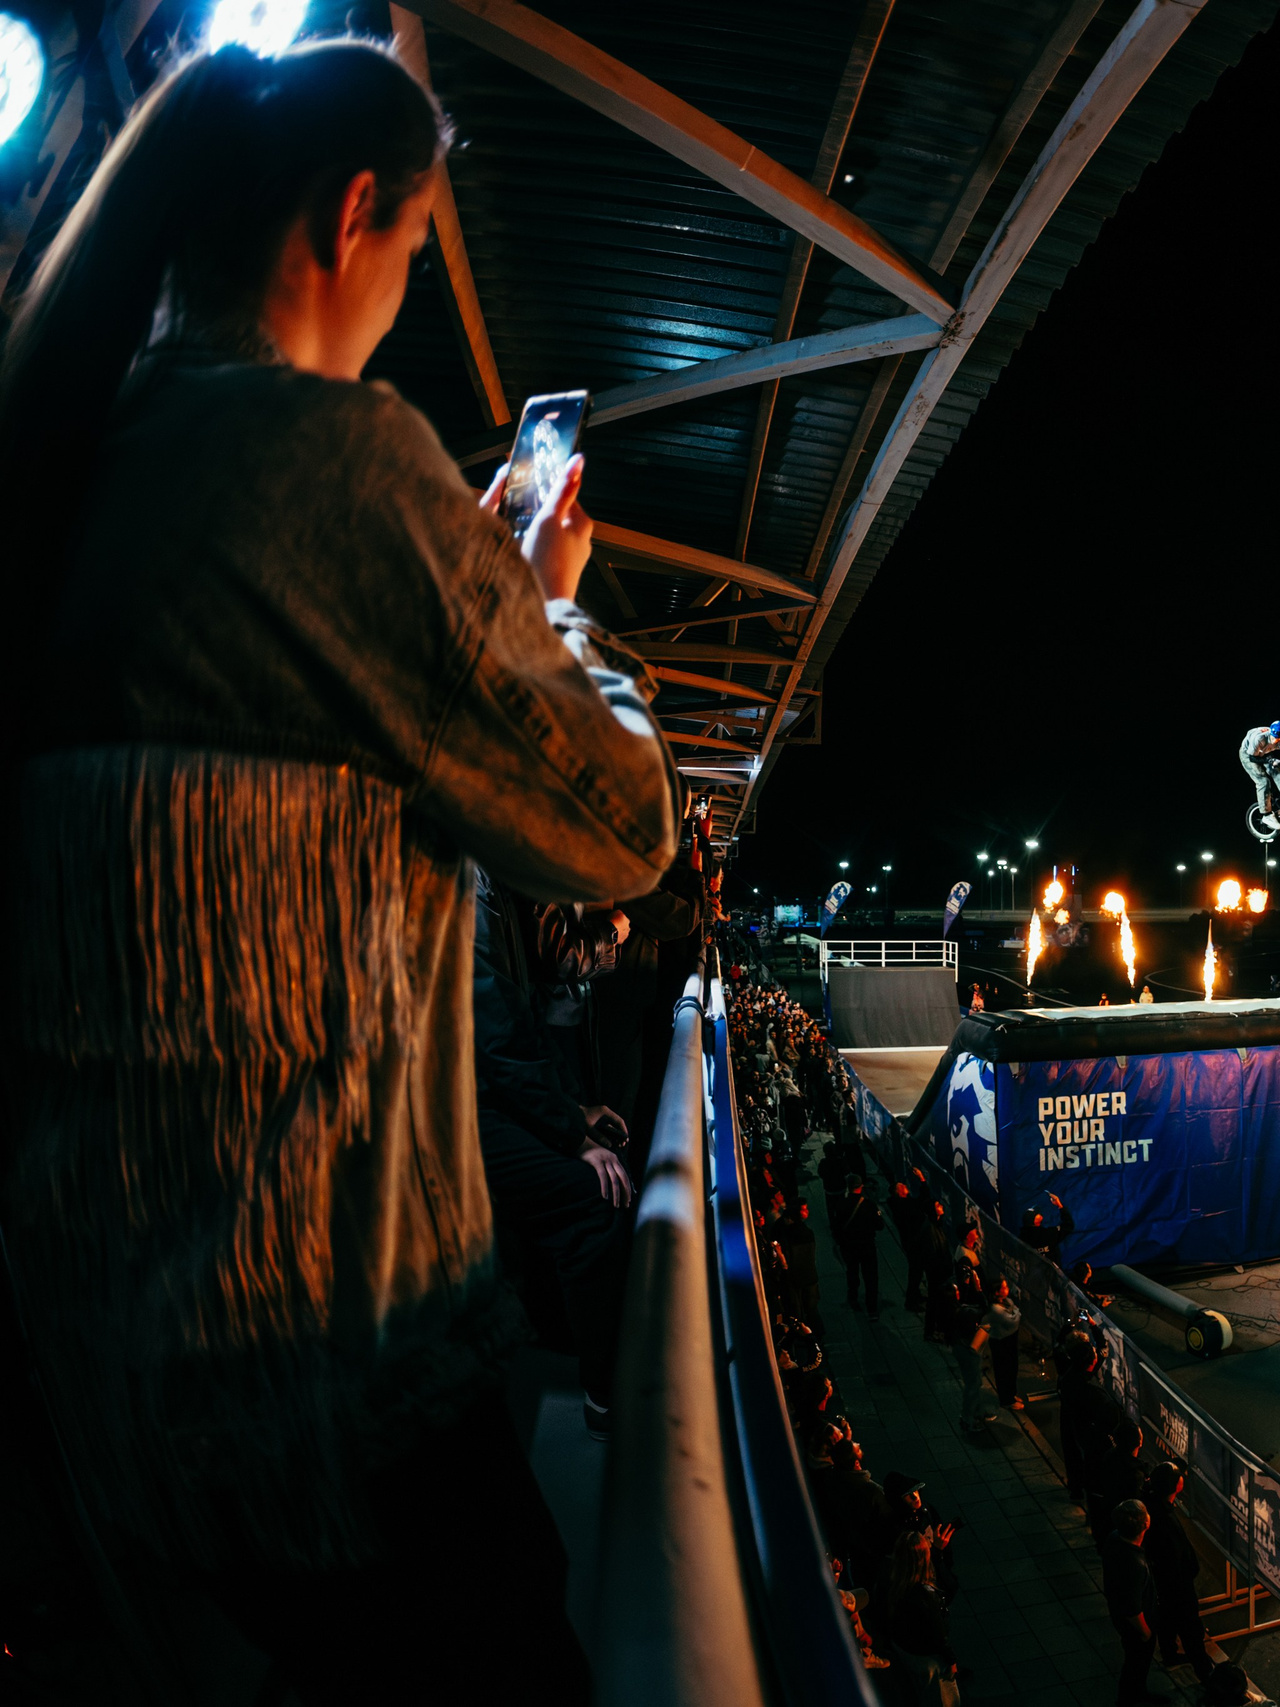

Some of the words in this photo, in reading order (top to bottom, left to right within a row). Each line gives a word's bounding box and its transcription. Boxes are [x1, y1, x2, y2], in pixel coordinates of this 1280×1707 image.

[1038, 1091, 1127, 1121] POWER
[1038, 1118, 1105, 1146] YOUR
[1039, 1138, 1153, 1171] INSTINCT
